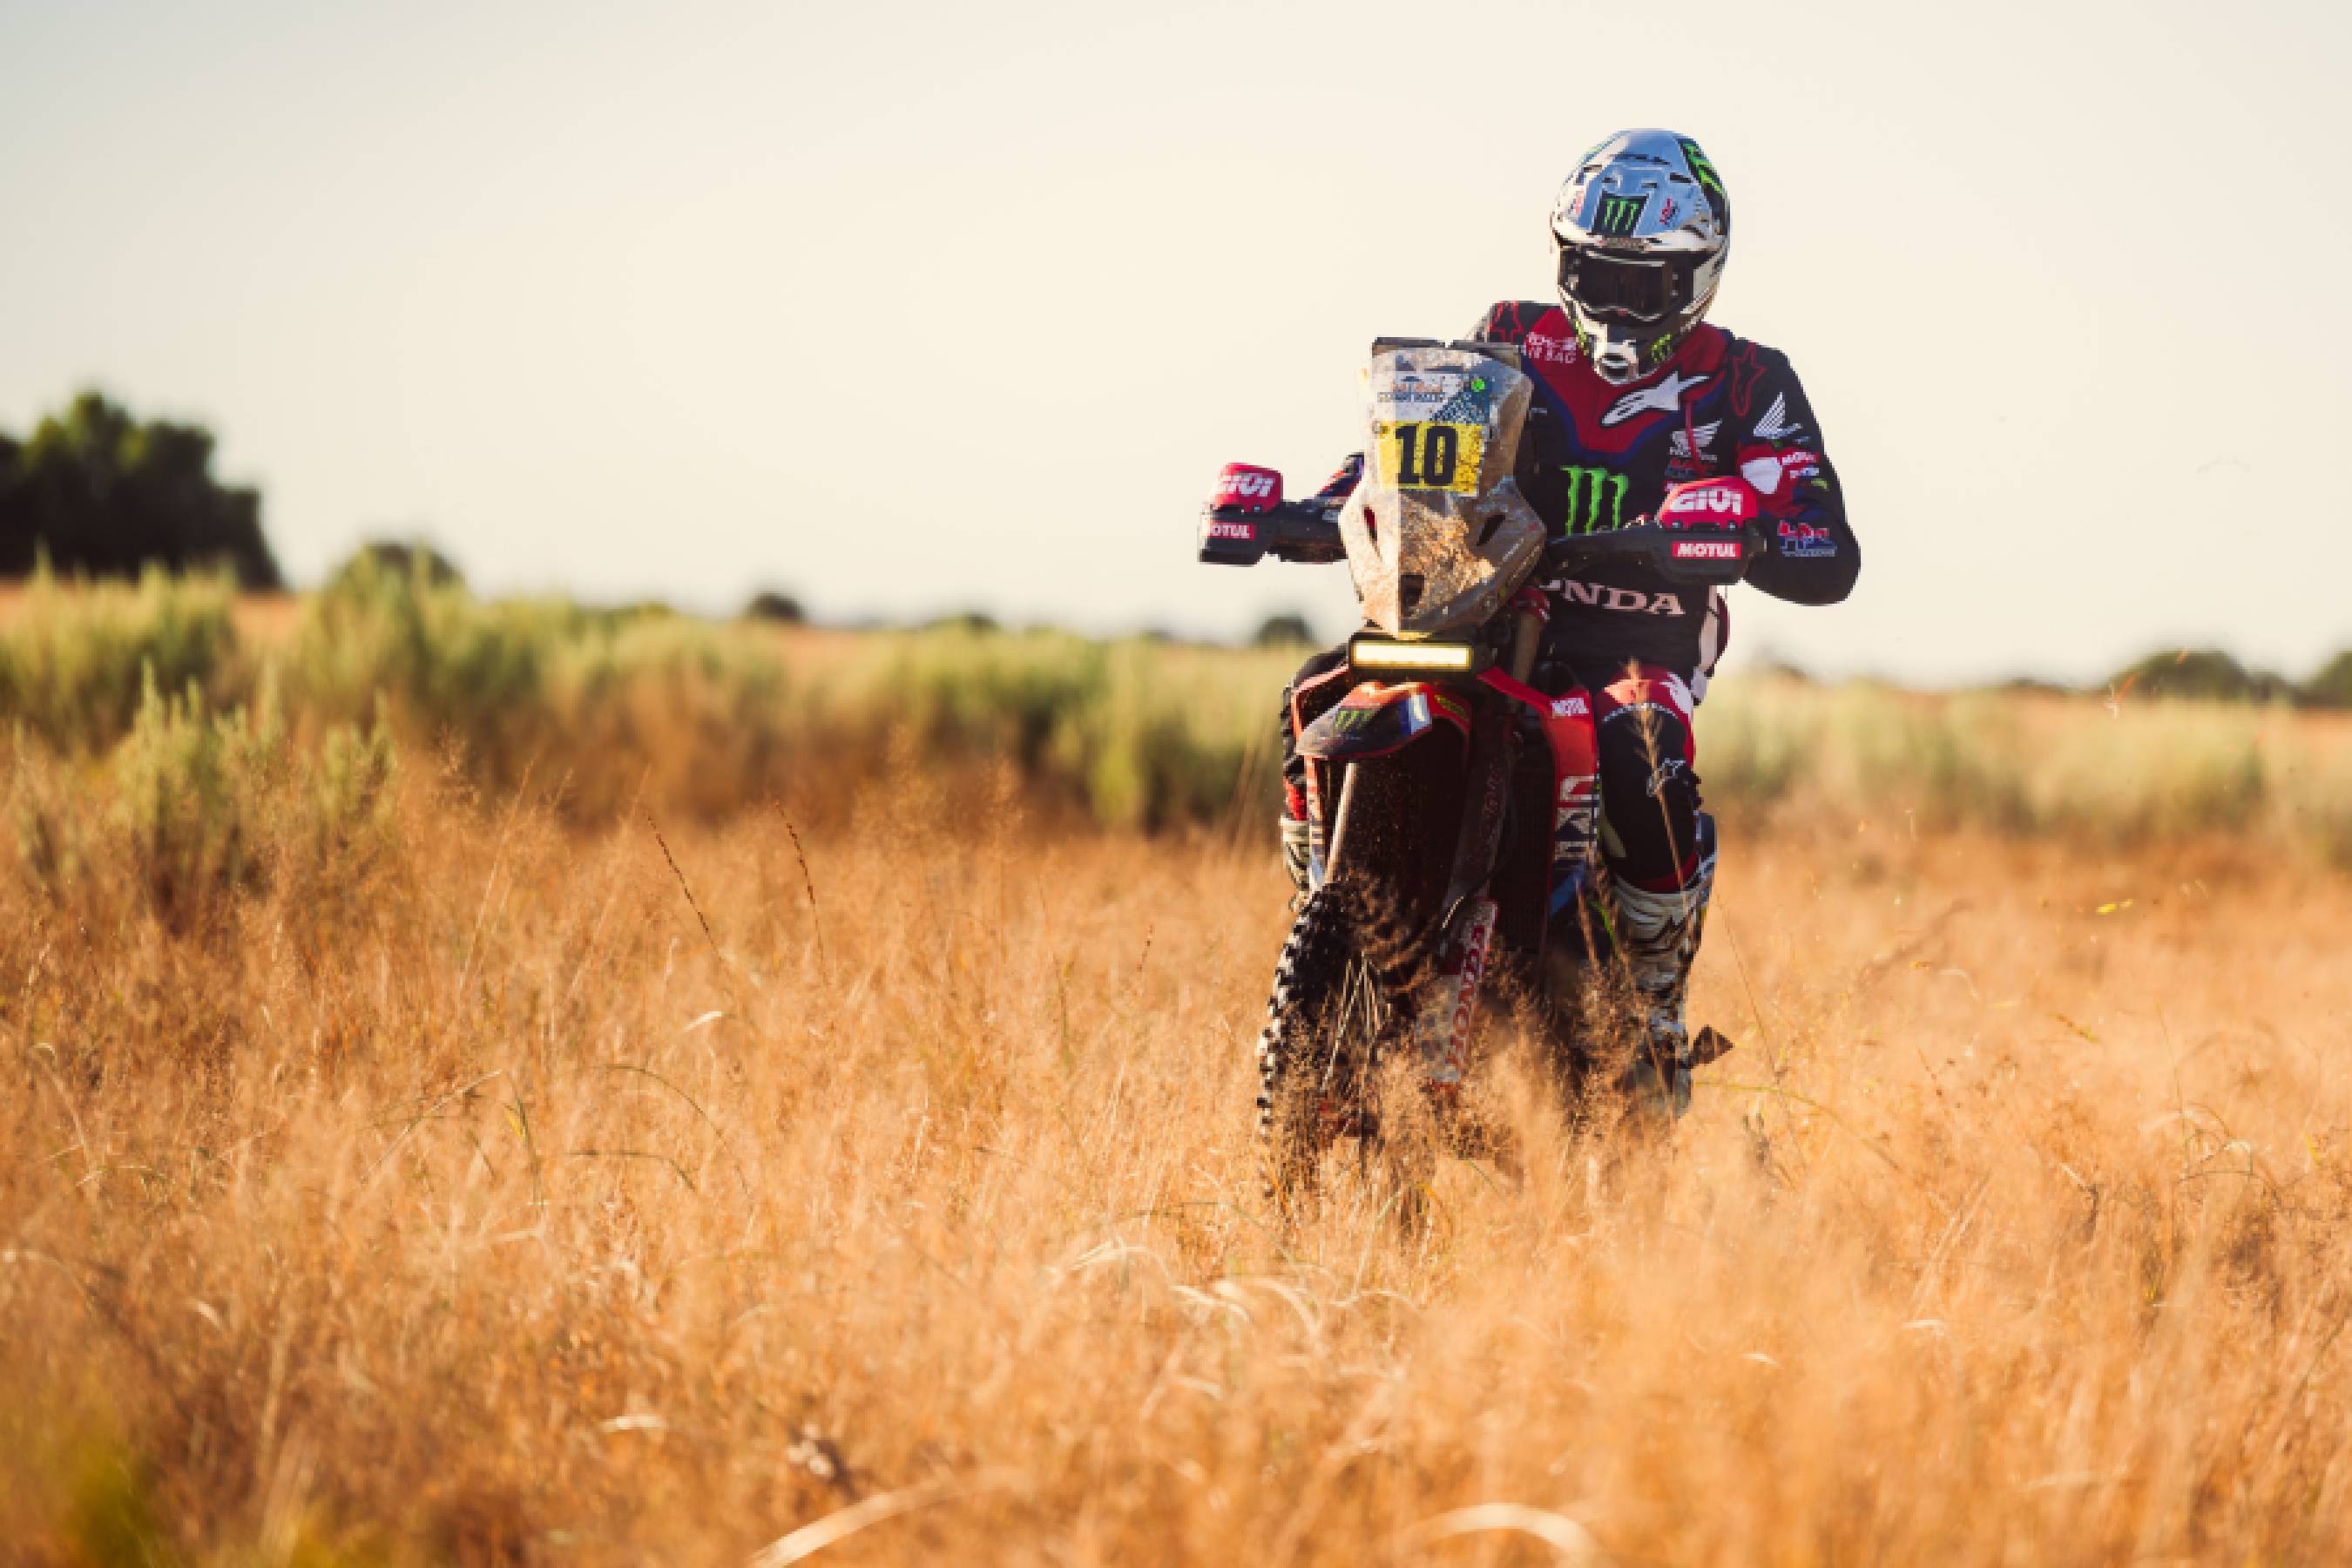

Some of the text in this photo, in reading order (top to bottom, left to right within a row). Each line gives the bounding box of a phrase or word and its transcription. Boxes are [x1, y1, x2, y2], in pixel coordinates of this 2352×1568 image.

[1396, 424, 1458, 487] 10
[1669, 487, 1741, 516] GIVI
[1207, 522, 1251, 538] OTUL
[1677, 542, 1736, 558] MOTUL
[1539, 578, 1686, 616] NDA
